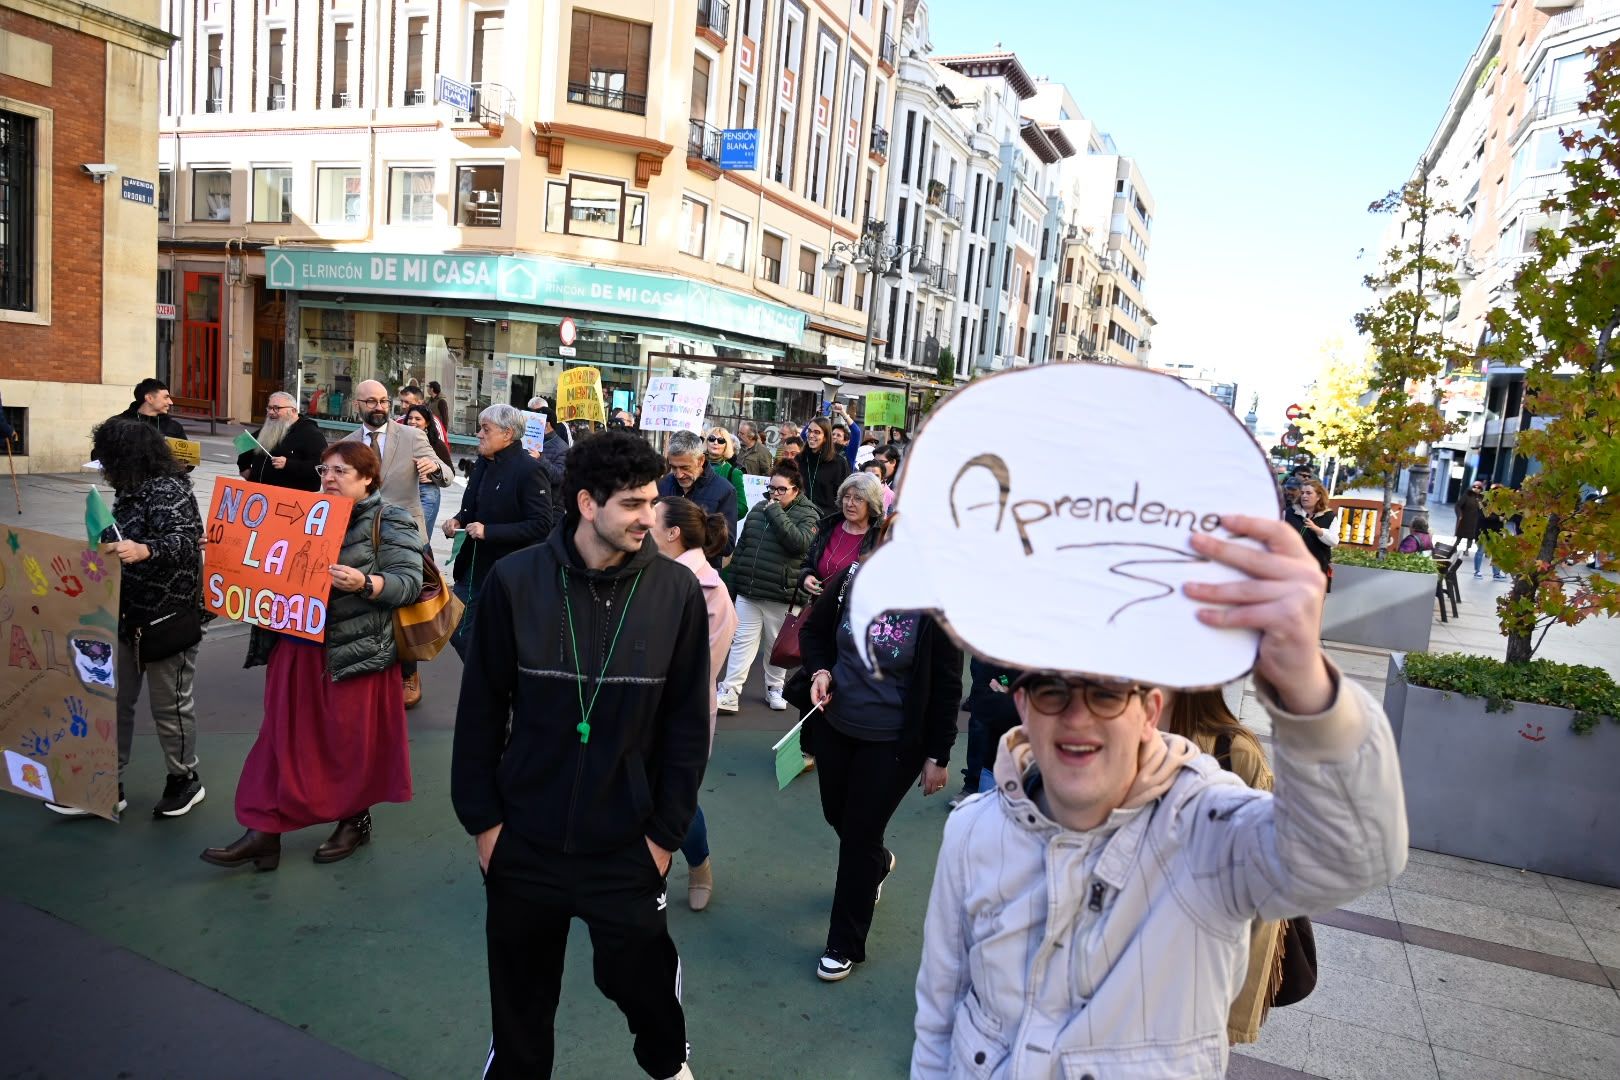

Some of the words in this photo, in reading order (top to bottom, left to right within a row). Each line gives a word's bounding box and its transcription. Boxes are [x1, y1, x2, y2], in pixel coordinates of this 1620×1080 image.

[723, 131, 756, 140] PENSIÓN
[726, 142, 754, 150] BLANCA
[129, 179, 154, 190] AVENIDA
[370, 257, 398, 282] DE
[402, 258, 427, 283] MI
[432, 259, 491, 286] CASA
[591, 283, 613, 299] DE
[617, 285, 637, 304] MI
[640, 290, 685, 307] CASA
[156, 304, 175, 315] ZZERIA
[215, 486, 269, 528] NO
[304, 500, 331, 536] A
[950, 453, 1223, 556] Aprendemo
[209, 524, 224, 544] 10
[242, 530, 289, 575] LA
[209, 572, 327, 635] SOLEDAD
